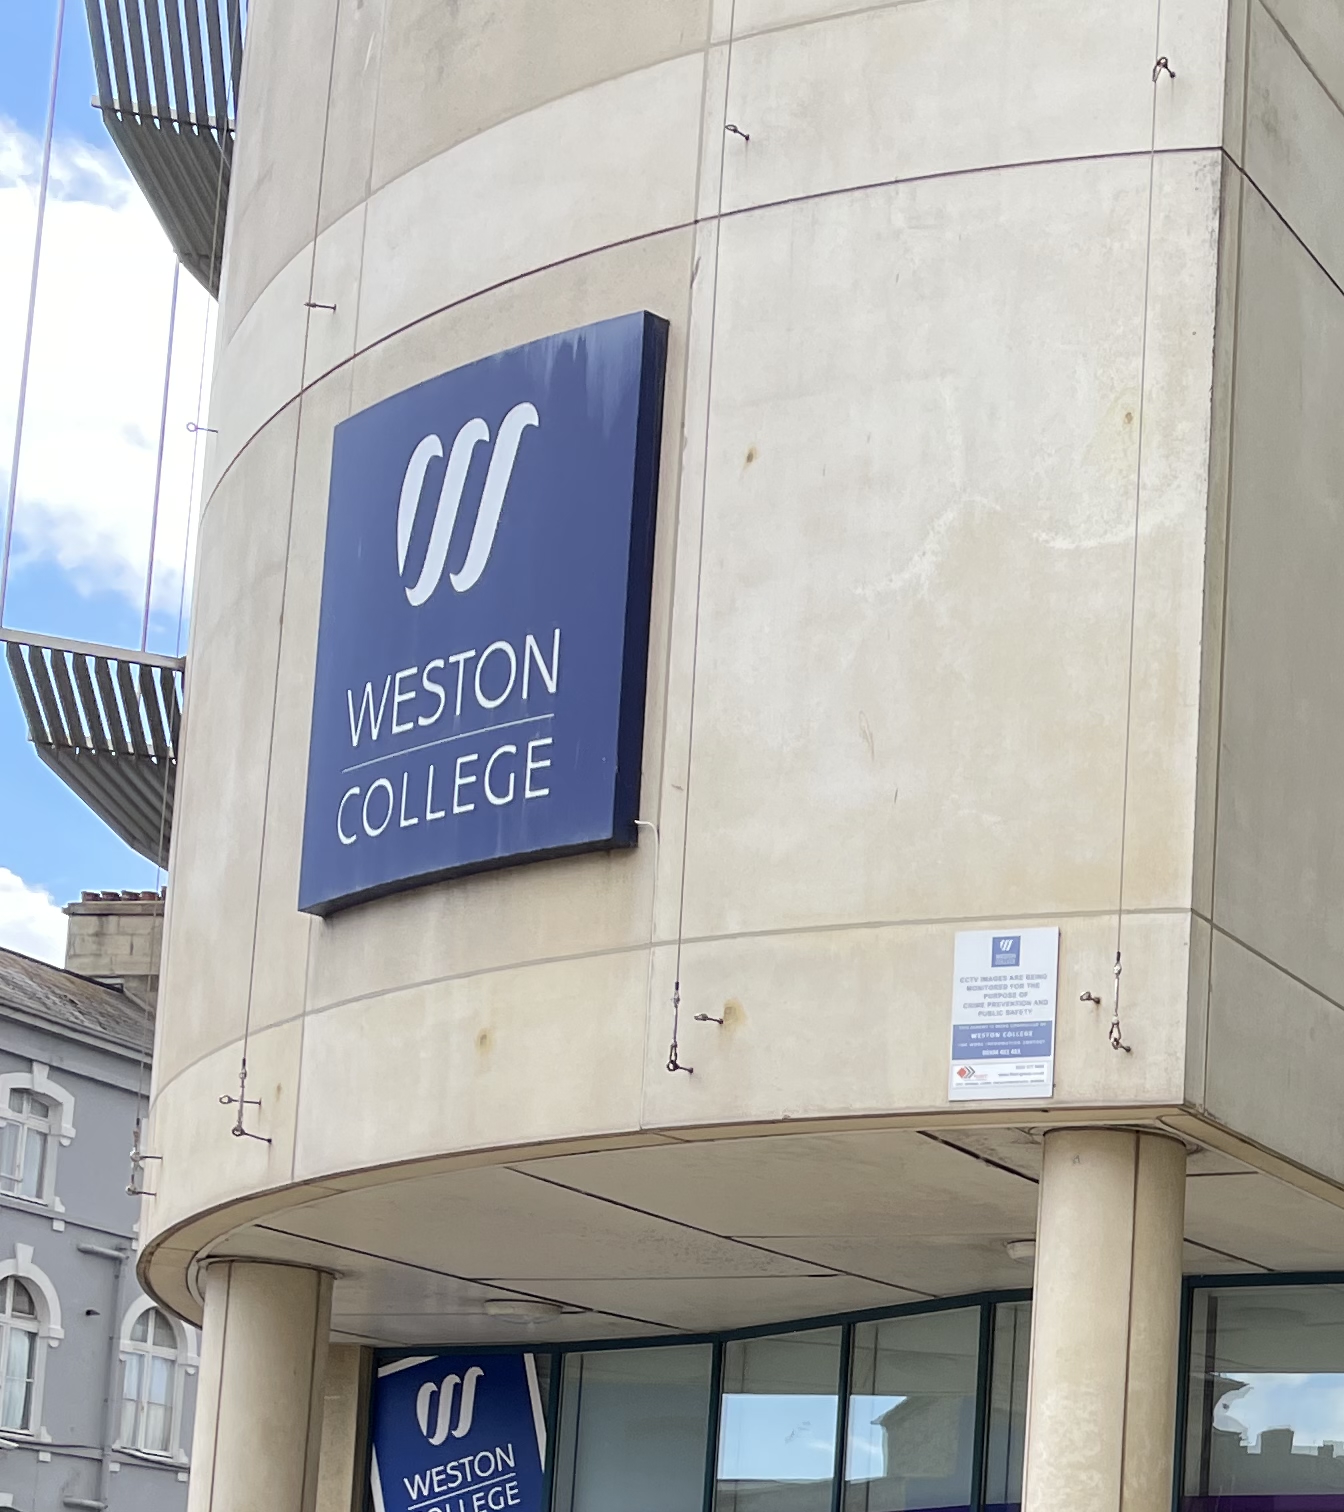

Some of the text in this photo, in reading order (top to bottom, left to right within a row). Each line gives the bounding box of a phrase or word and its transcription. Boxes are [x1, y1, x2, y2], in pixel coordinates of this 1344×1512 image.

[346, 628, 561, 747] WESTON
[337, 738, 553, 846] COLLEGE
[960, 976, 979, 984] CCTV
[966, 983, 1008, 992] MONITORED
[987, 1000, 1032, 1008] PREVENTION
[977, 1008, 1033, 1017] PUBLIC SAFETY
[970, 1030, 1034, 1039] WESTON COLLEGE
[403, 1443, 516, 1500] WESTON
